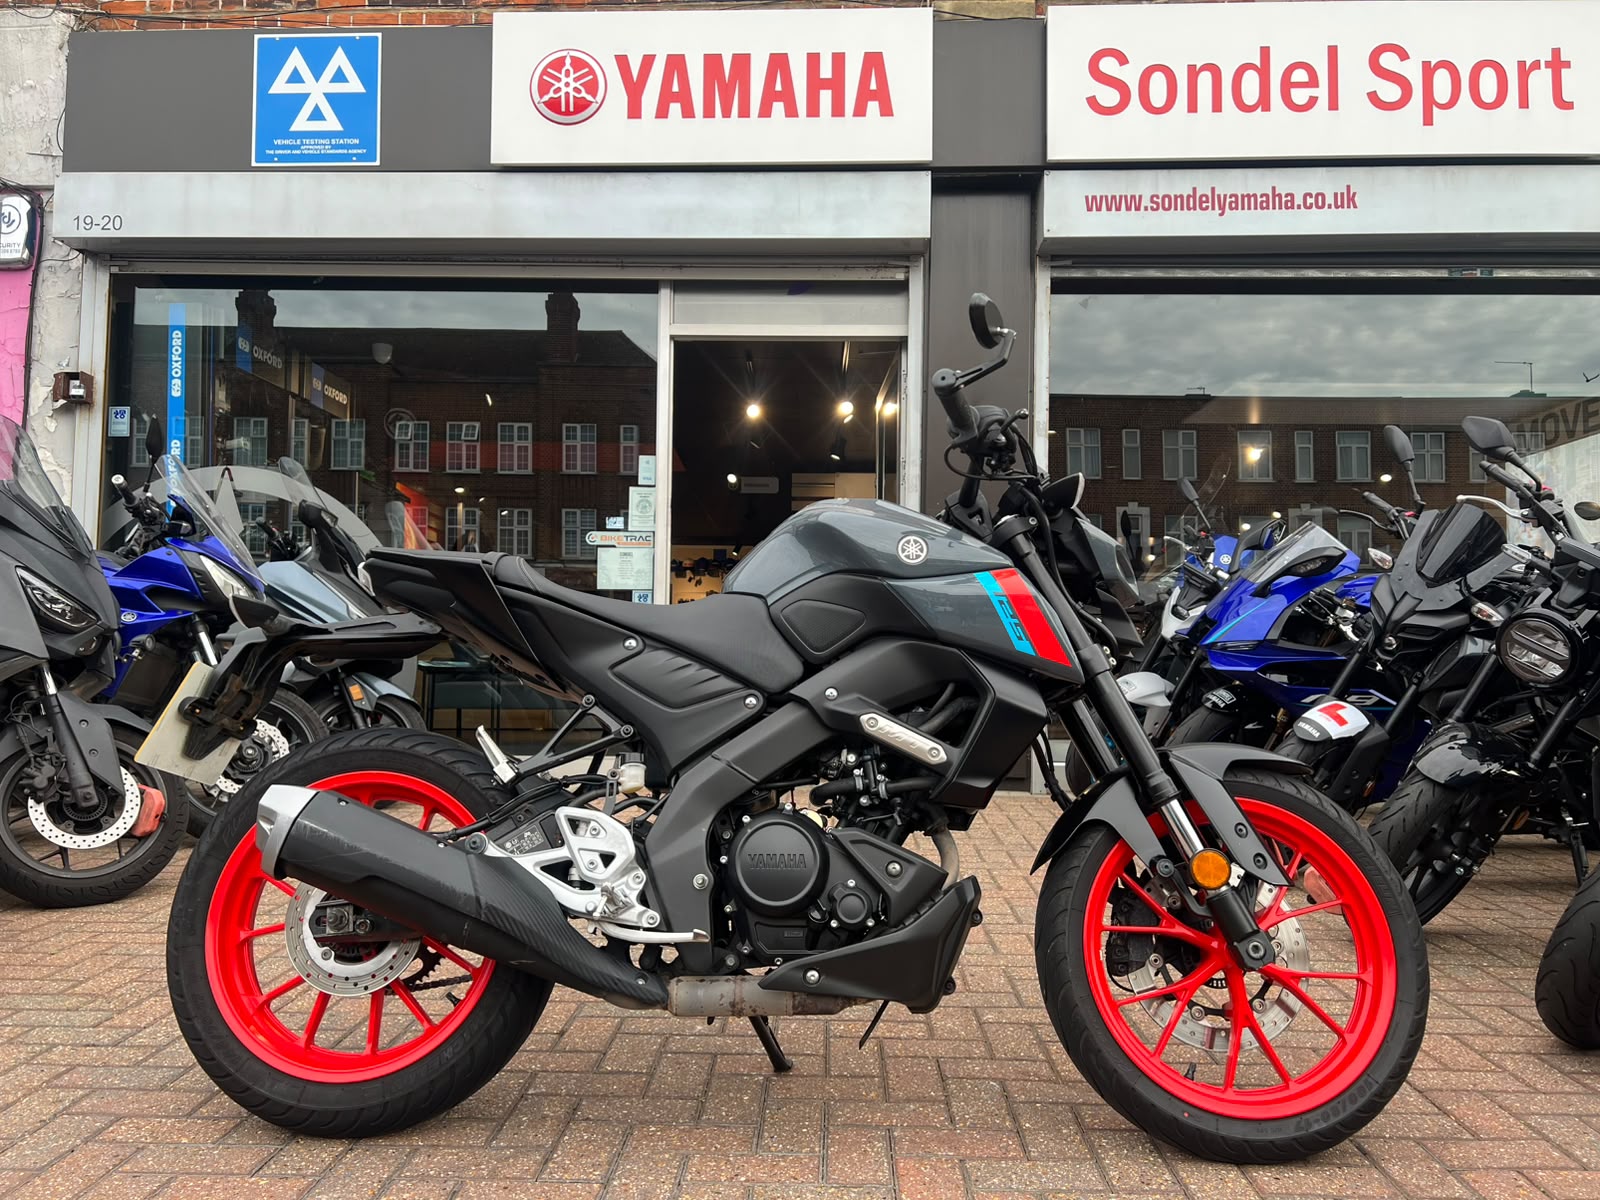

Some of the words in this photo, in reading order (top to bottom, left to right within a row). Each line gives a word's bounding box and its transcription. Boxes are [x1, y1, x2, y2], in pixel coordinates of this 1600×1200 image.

[614, 52, 894, 120] YAMAHA
[1085, 44, 1339, 116] Sondel
[1366, 42, 1575, 126] Sport
[1084, 184, 1359, 217] www.sondelyamaha.co.uk
[73, 215, 123, 231] 19-20
[171, 330, 183, 377] OXFORD
[252, 345, 283, 369] OXFORD
[324, 384, 348, 405] OXFORD
[993, 591, 1030, 642] 125
[1297, 721, 1321, 739] YAMAHA
[747, 853, 807, 869] YAMAHA
